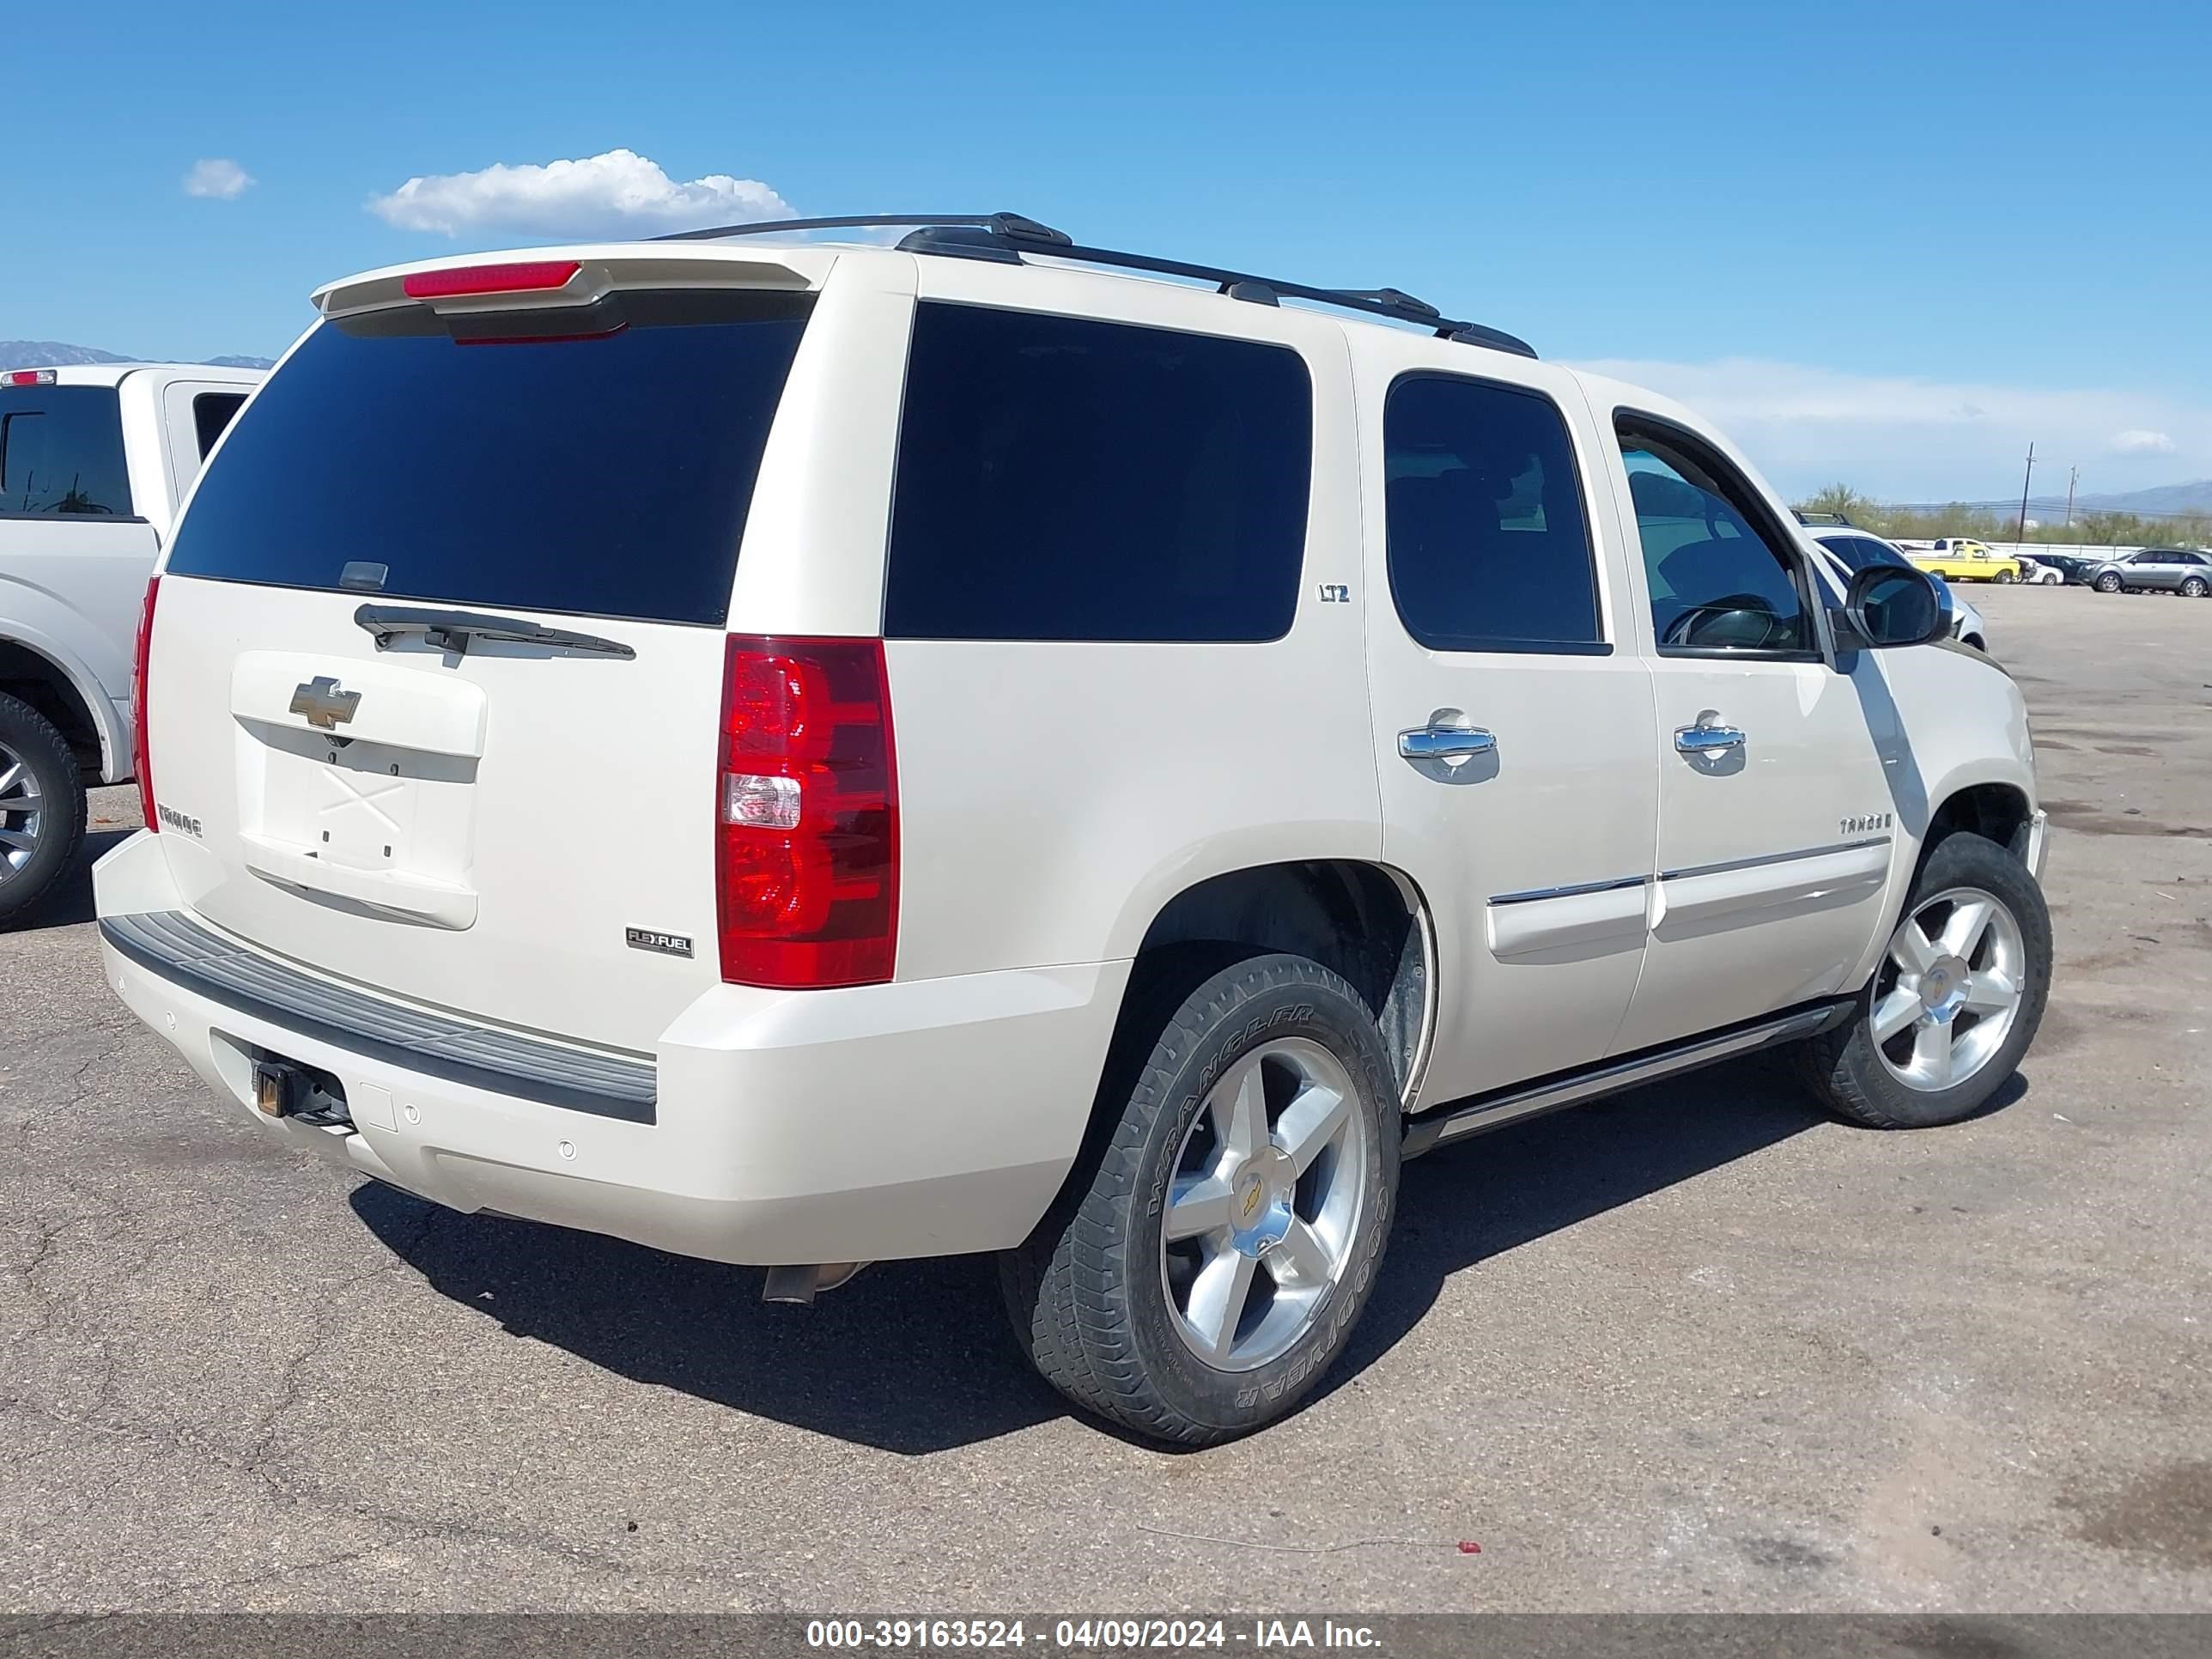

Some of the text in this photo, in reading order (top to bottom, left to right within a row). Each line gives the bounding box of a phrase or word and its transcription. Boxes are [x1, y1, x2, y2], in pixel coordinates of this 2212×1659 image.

[1319, 584, 1350, 603] LTZ
[1147, 1004, 1314, 1218] WRANGLER
[1237, 1187, 1389, 1410] GOODYEAR
